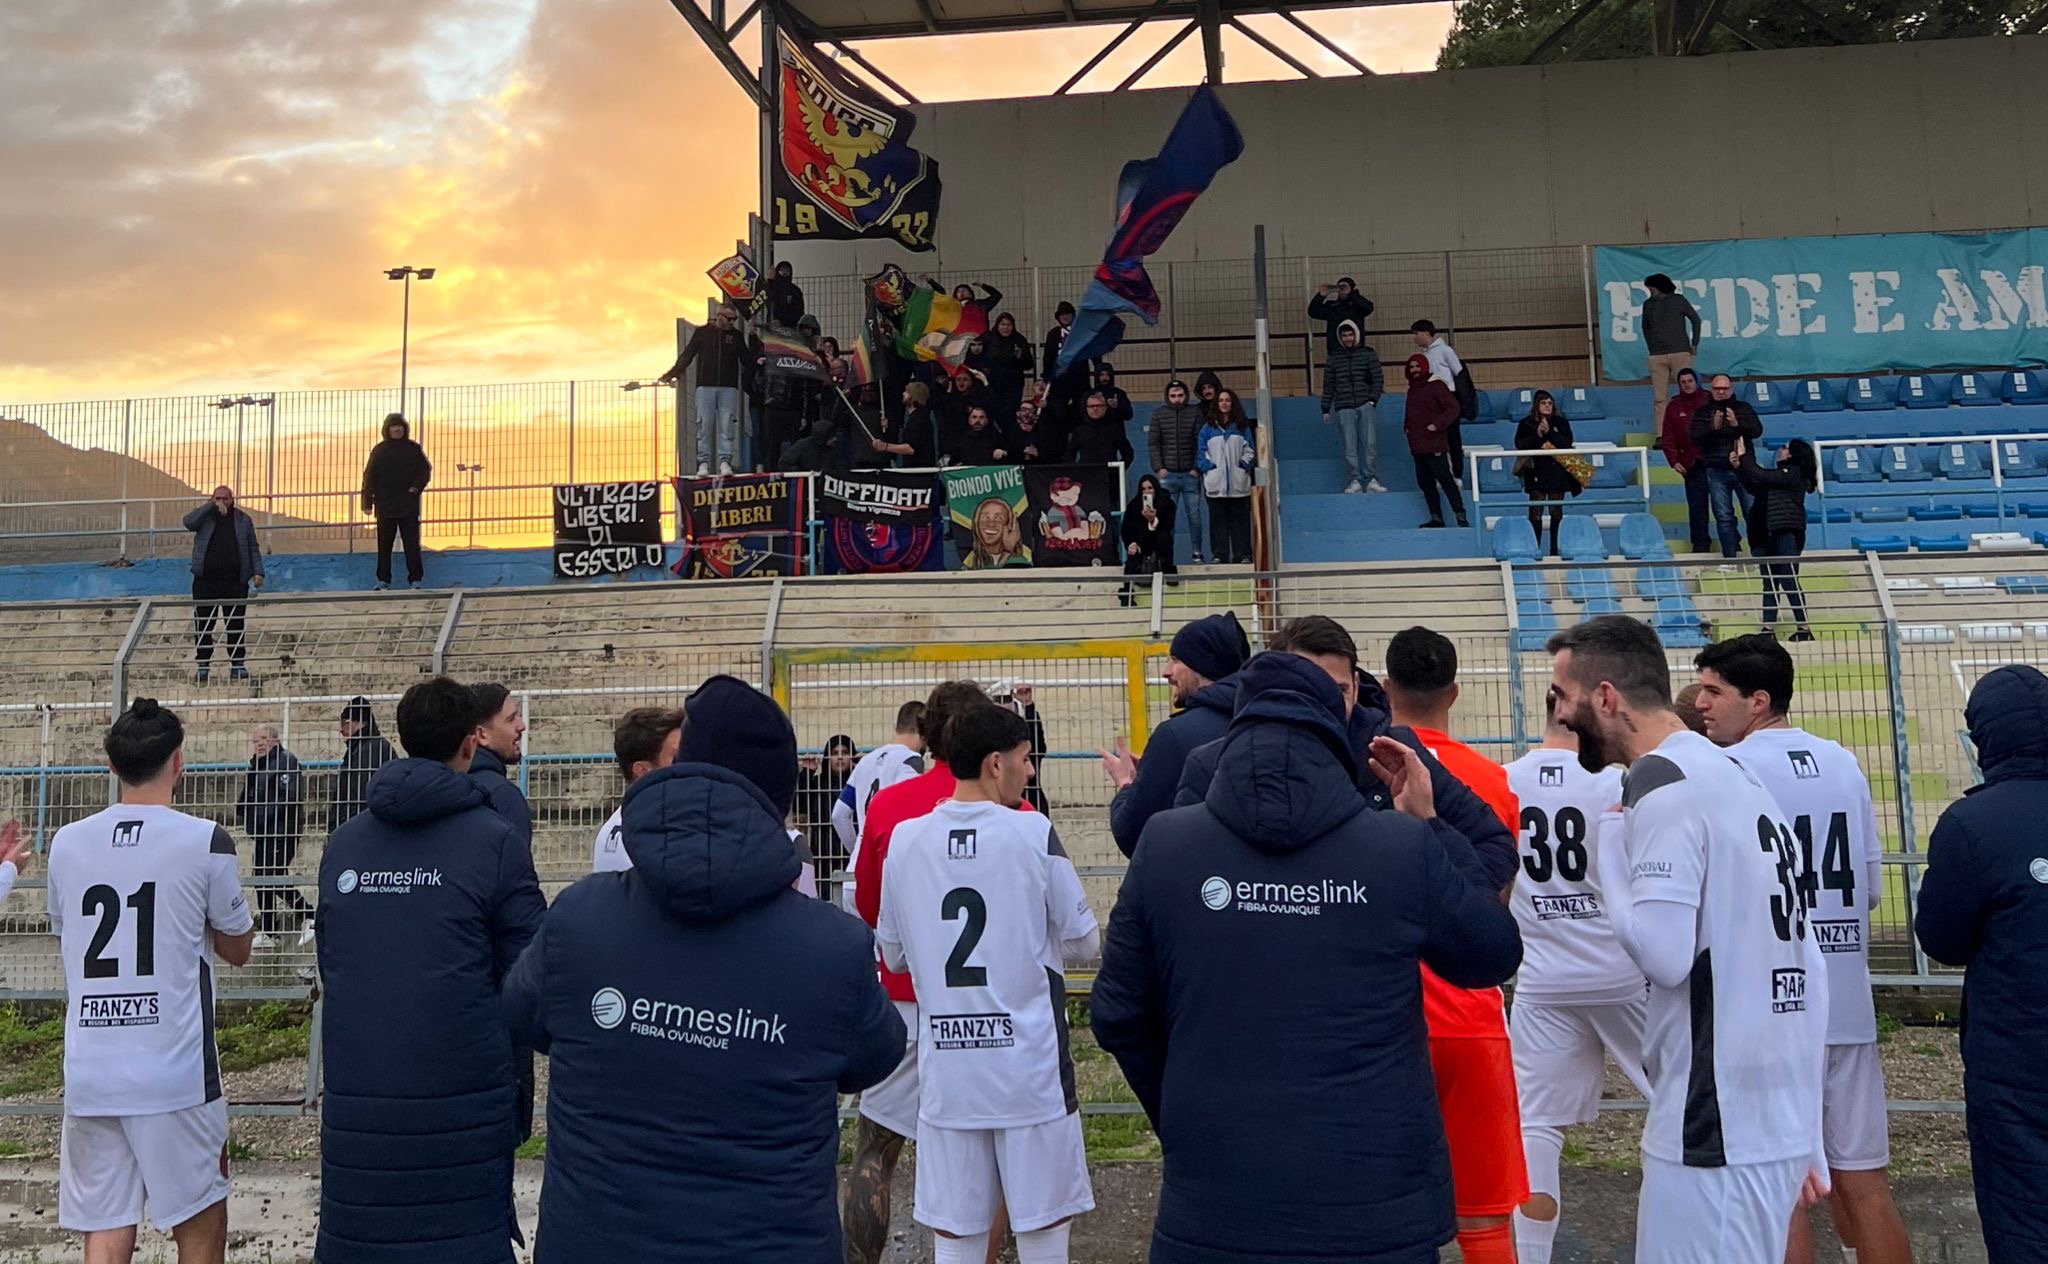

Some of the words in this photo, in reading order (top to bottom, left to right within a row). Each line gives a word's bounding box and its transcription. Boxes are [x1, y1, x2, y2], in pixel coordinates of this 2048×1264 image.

[775, 197, 819, 234] 19
[1849, 271, 1905, 334] E
[556, 481, 657, 507] ULTRAS
[693, 482, 788, 507] DIFFIDATI
[824, 474, 932, 507] DIFFIDATI
[948, 474, 992, 499] BIONDO
[993, 466, 1023, 490] VIVE
[563, 502, 637, 528] LIBERI
[710, 505, 773, 528] LIBERI
[588, 525, 613, 547] DI
[1518, 806, 1588, 883] 38
[360, 867, 442, 887] ermeslink
[380, 886, 411, 894] OVUNQUE
[1236, 879, 1368, 904] ermeslink
[1531, 894, 1598, 913] FRANZY'S
[1238, 901, 1269, 912] FIBRA
[1269, 904, 1321, 916] OVUNQUE
[81, 882, 156, 979] 21
[941, 886, 987, 988] 2
[1812, 919, 1860, 943] NZY'S
[80, 992, 159, 1017] FRANZY'S
[632, 997, 787, 1044] ermeslink
[930, 1013, 1013, 1039] FRANZY'S
[630, 1021, 666, 1040] FIBRA
[667, 1029, 729, 1050] OVUNQUE
